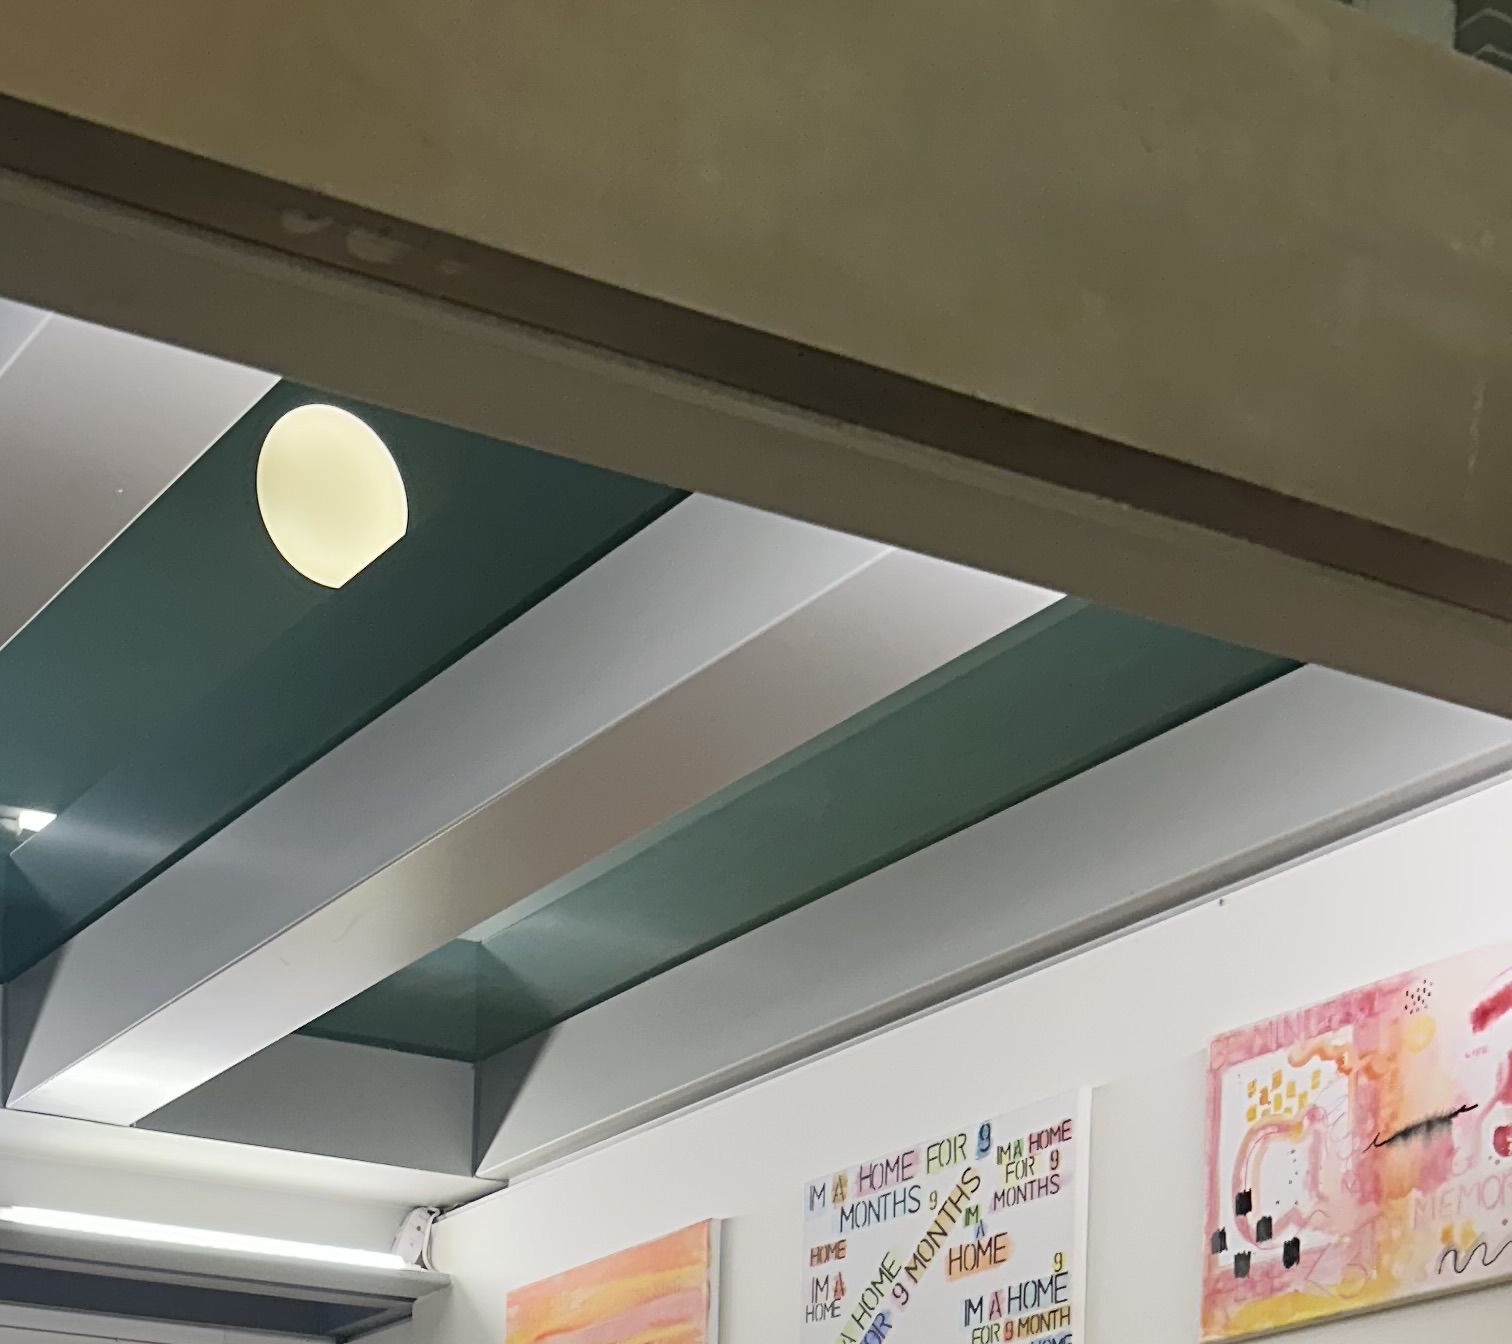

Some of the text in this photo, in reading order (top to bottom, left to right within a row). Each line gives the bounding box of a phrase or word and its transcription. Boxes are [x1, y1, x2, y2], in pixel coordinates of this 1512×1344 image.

[996, 1118, 1072, 1165] IM A HOME
[833, 1174, 847, 1204] A
[859, 1150, 915, 1193] HOME
[926, 1133, 967, 1174] FOR
[978, 1122, 991, 1153] 9
[1005, 1149, 1060, 1183] FOR 9
[839, 1184, 938, 1234] MONTHS 9
[993, 1173, 1061, 1211] MONTHS
[892, 1282, 910, 1306] 9
[904, 1166, 981, 1284] MONTHS
[975, 1219, 986, 1238] A
[810, 1239, 847, 1267] HOME
[949, 1231, 1008, 1275] HOME
[1053, 1251, 1064, 1273] 9
[811, 1271, 846, 1304] IM A
[851, 1251, 902, 1331] HOME
[988, 1291, 1002, 1321] A
[1007, 1272, 1069, 1315] HOME
[805, 1298, 841, 1324] HOME
[1017, 1306, 1071, 1338] MONTH
